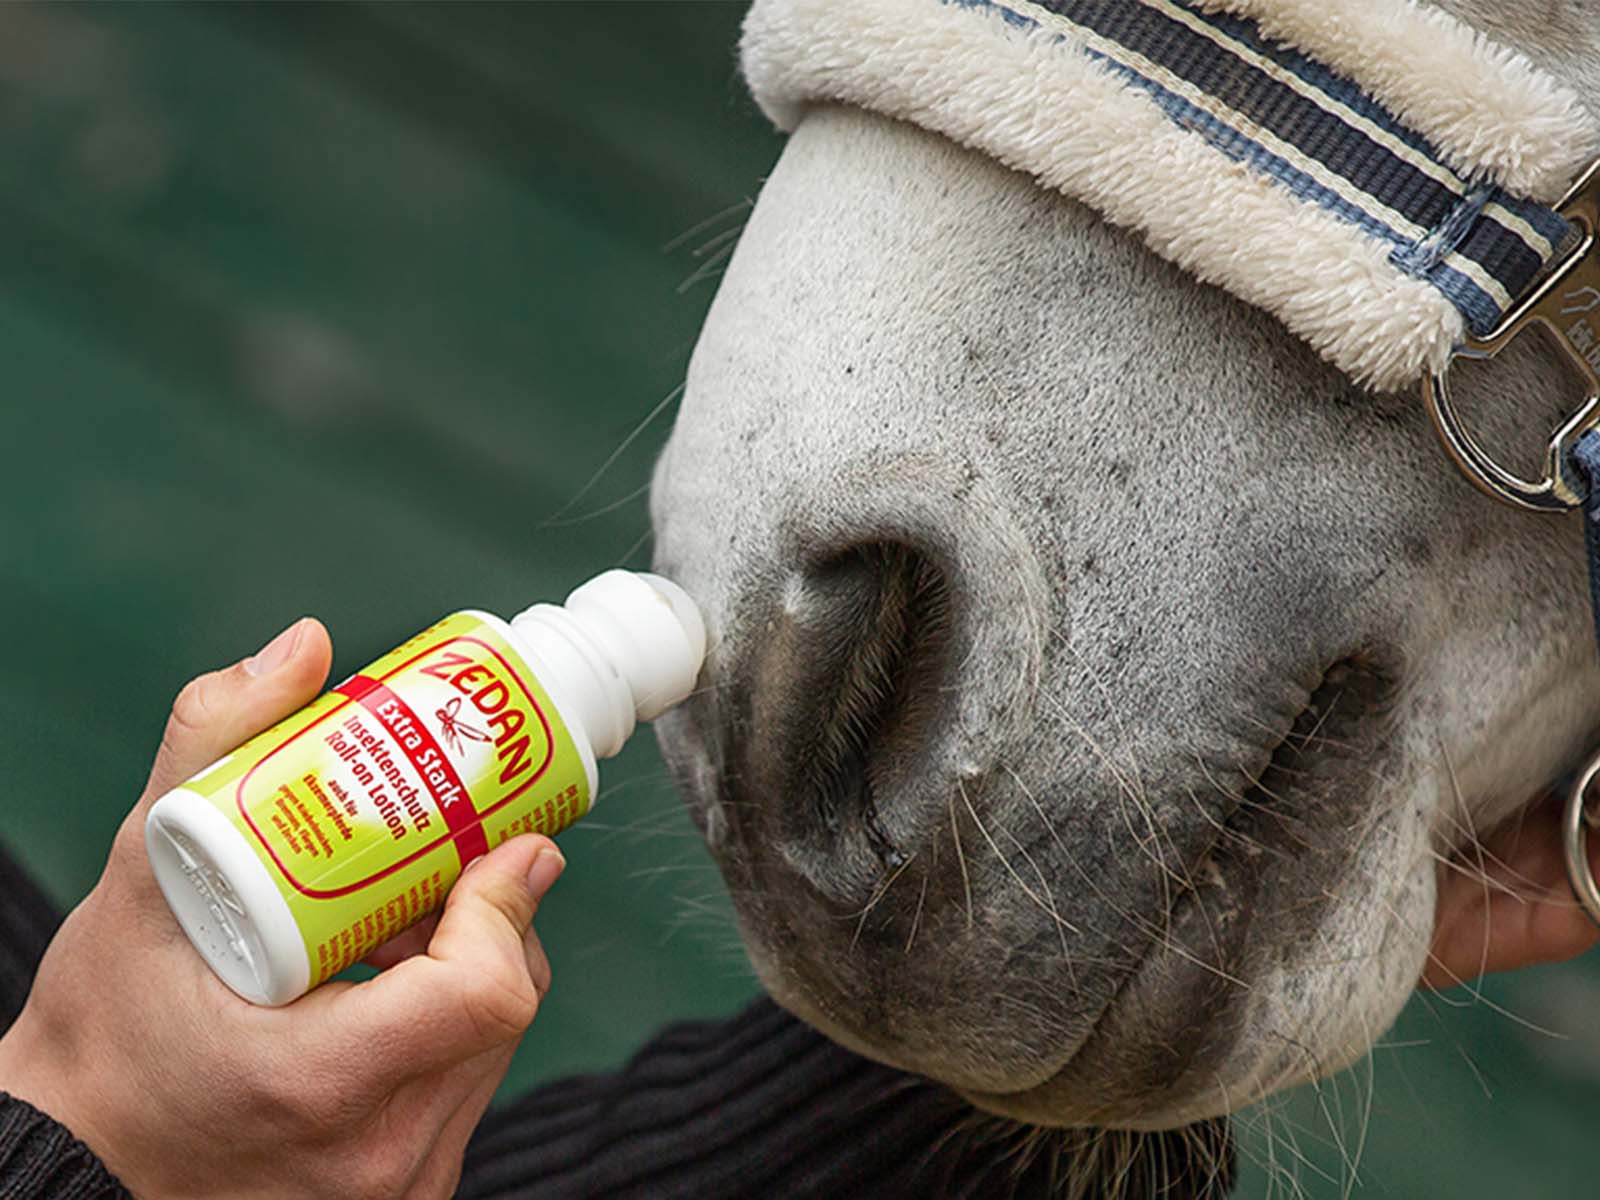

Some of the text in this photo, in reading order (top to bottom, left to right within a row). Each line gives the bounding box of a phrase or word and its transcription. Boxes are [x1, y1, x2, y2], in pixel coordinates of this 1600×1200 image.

[342, 713, 430, 832] Insektenschutz
[376, 698, 462, 808] Extra Stark
[417, 651, 531, 785] ZEDAN
[302, 773, 353, 841] Ekzemerpferde
[323, 729, 406, 840] Roll-on Lotion
[327, 778, 359, 818] auch für
